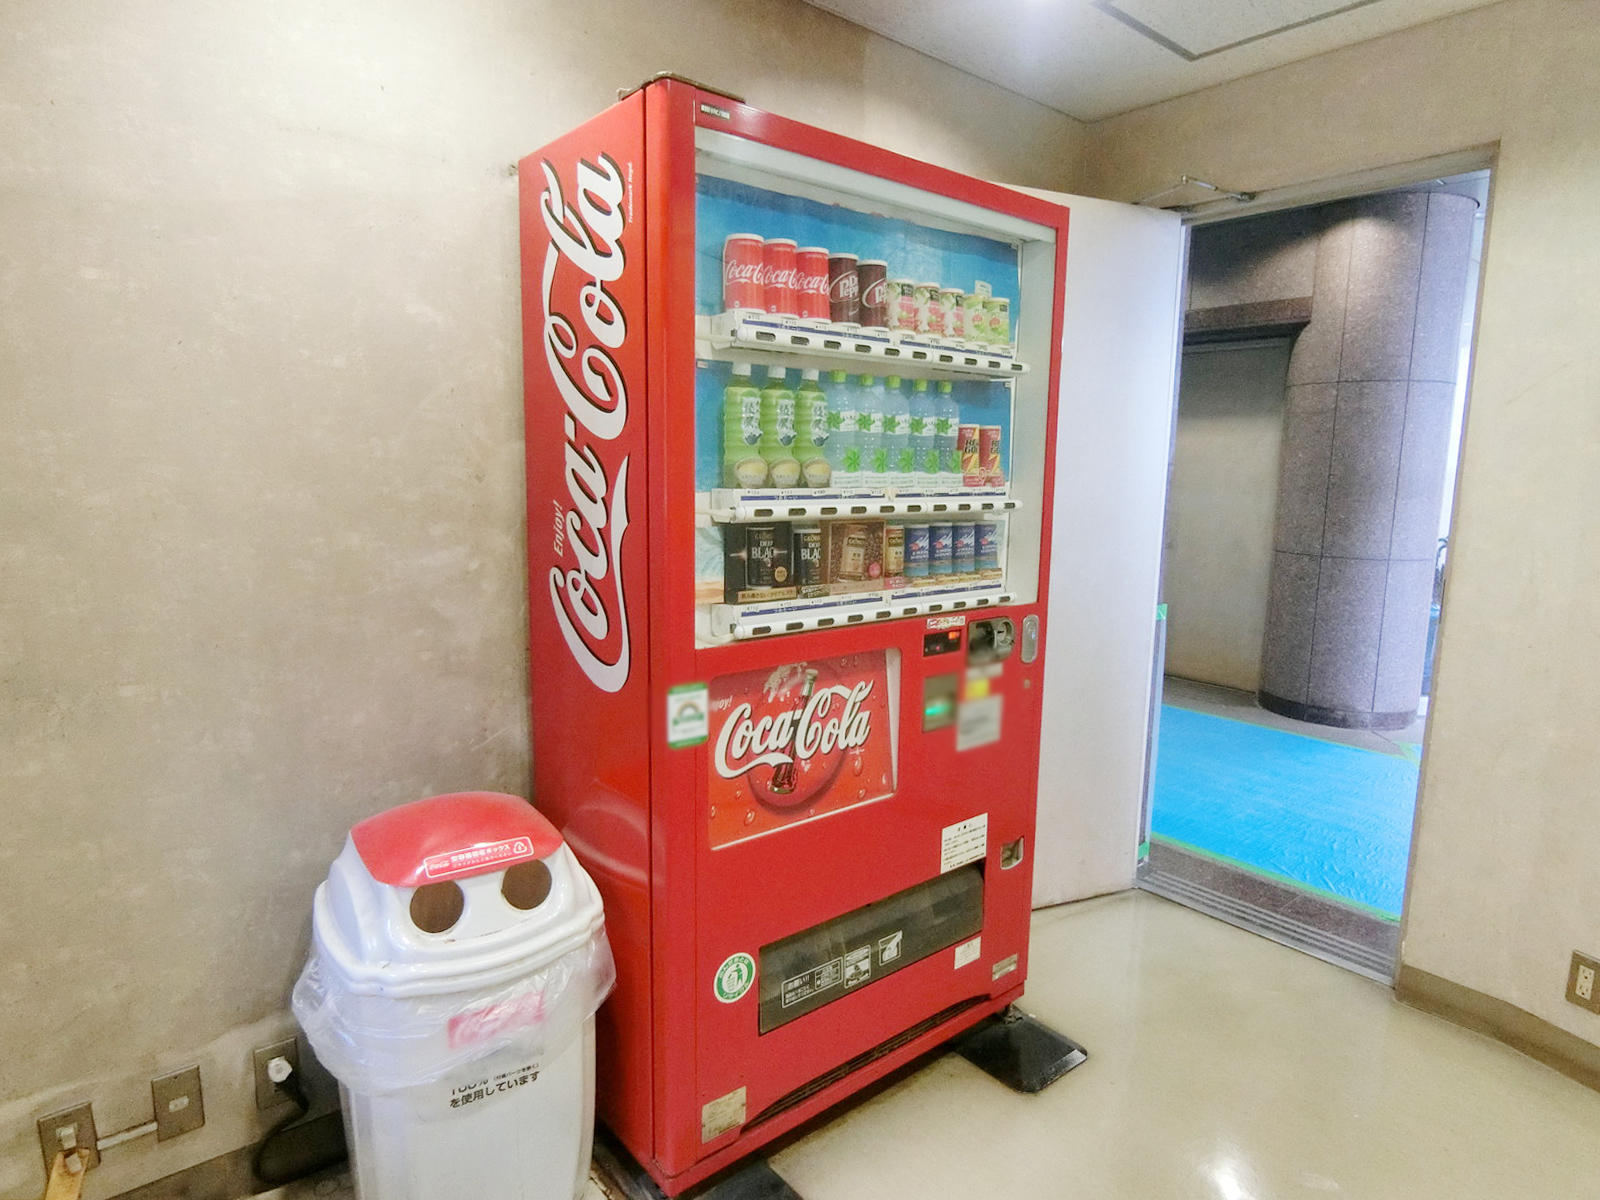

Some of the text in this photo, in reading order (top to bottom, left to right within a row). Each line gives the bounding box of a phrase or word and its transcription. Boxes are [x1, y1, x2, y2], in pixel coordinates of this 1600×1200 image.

[540, 151, 630, 693] Coca-Cola
[552, 499, 564, 558] Enjoy!
[714, 679, 874, 779] Coca-Cola
[449, 1071, 540, 1108] を使用しています
